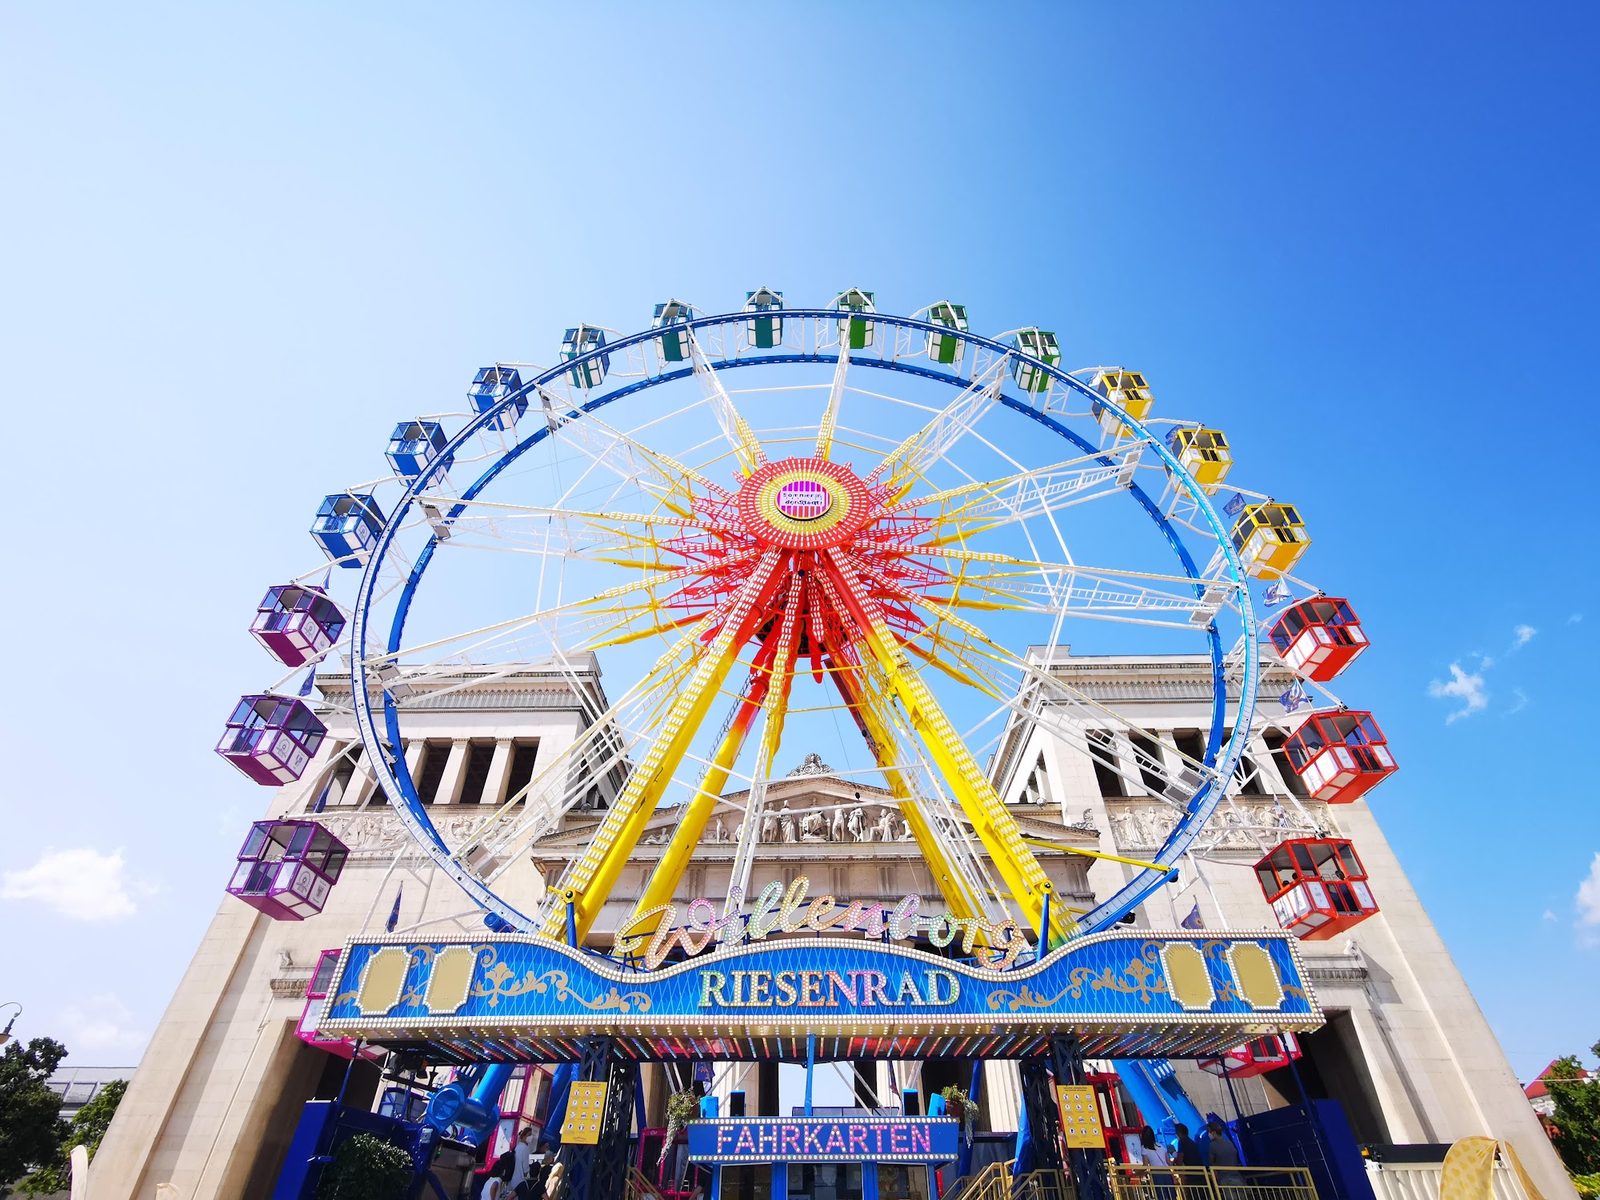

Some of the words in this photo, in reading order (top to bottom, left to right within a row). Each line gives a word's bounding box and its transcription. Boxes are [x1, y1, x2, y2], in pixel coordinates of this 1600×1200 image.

[614, 874, 1026, 971] Willenborg
[699, 969, 961, 1007] RIESENRAD
[717, 1124, 931, 1155] FAHRKARTEN
